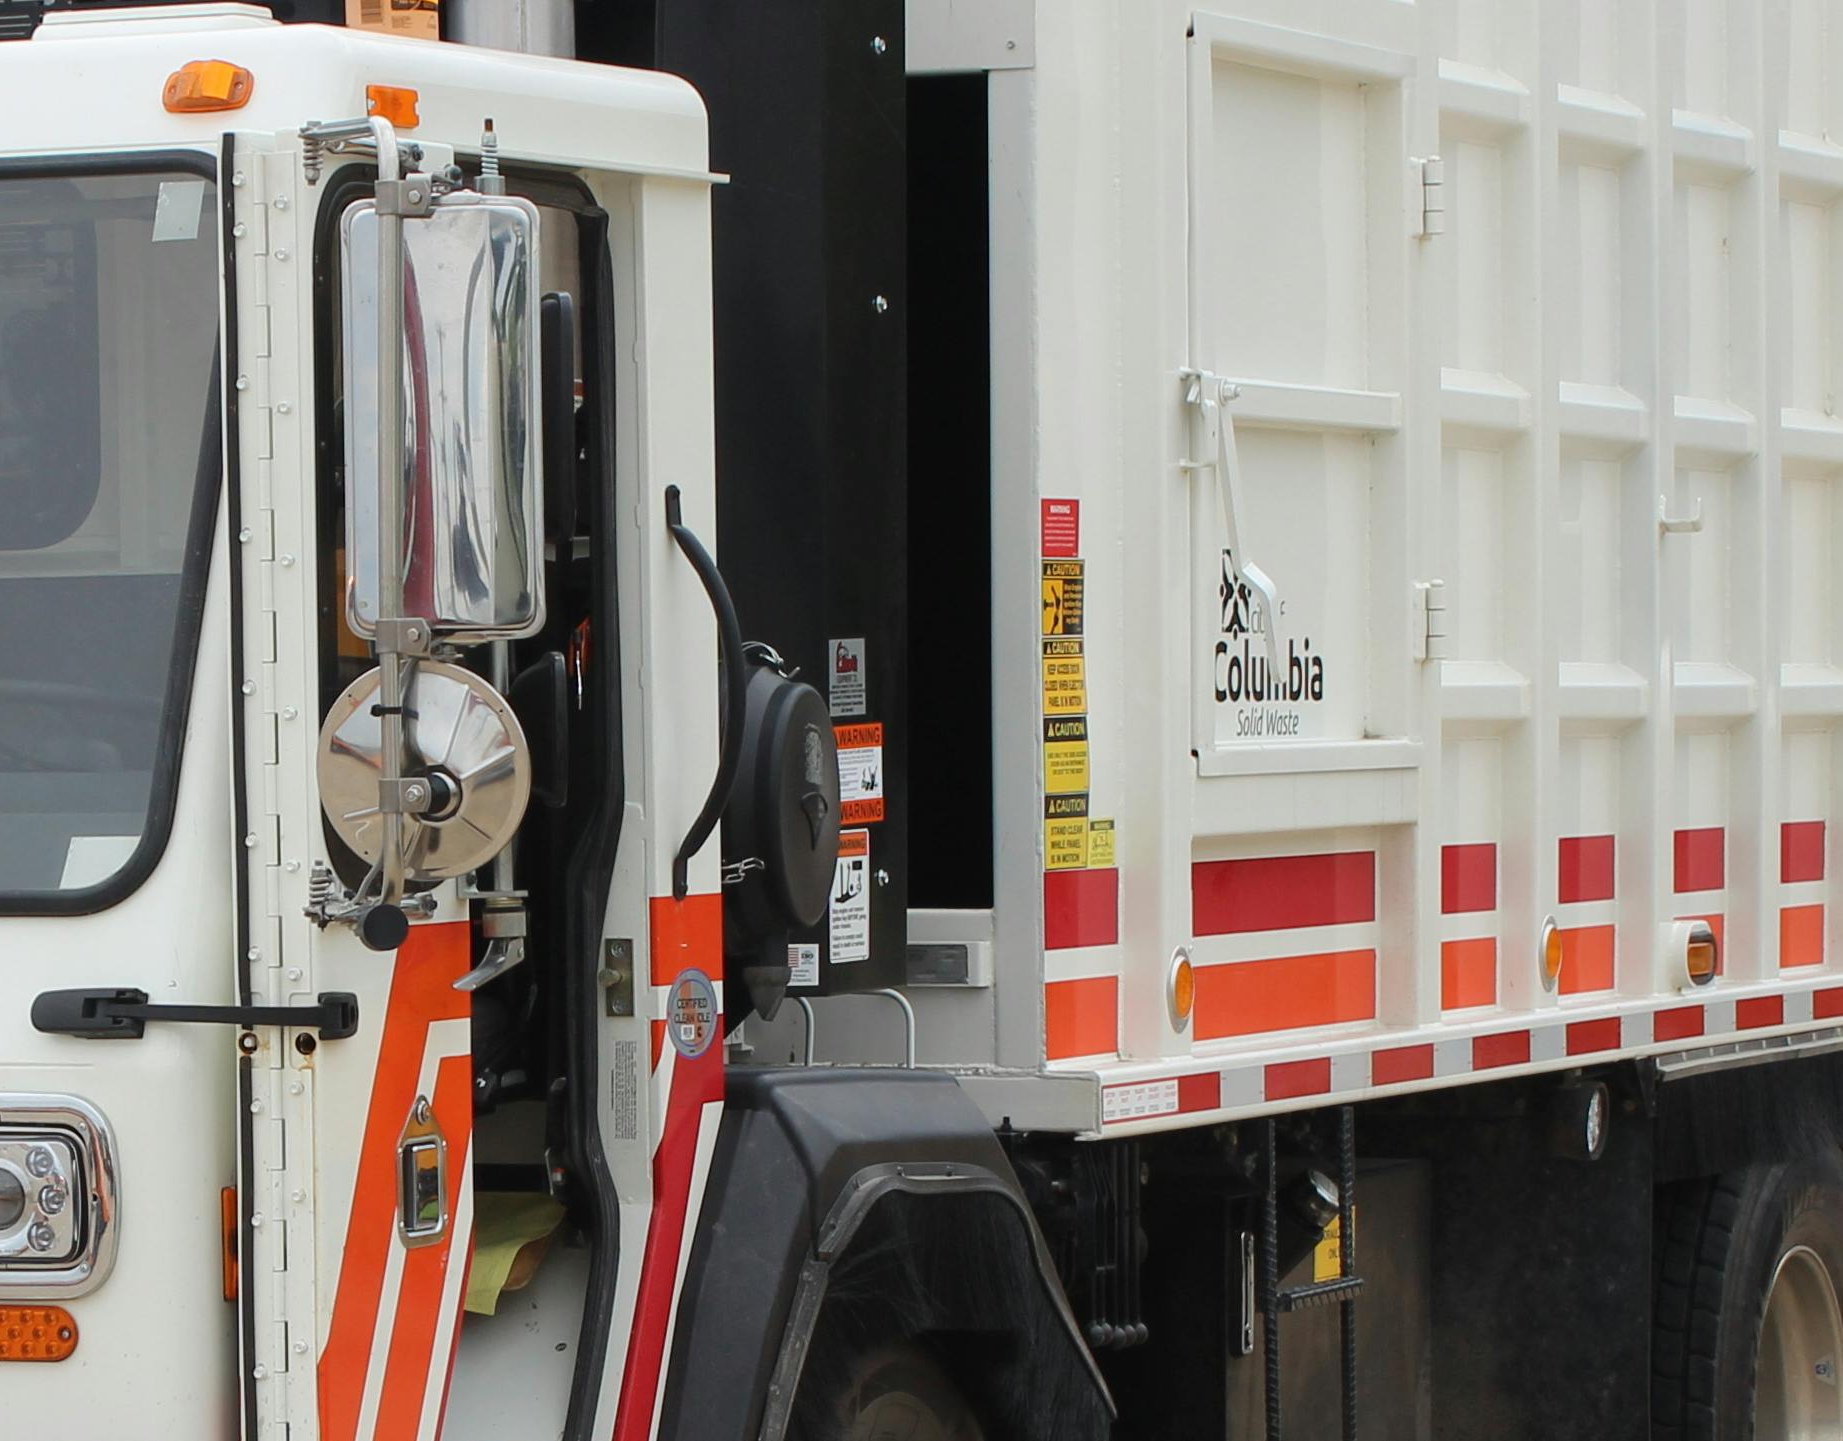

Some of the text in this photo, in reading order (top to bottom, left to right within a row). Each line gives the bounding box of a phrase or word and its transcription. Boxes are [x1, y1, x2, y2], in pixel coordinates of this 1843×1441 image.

[1052, 564, 1080, 576] CAUTION
[1052, 641, 1080, 654] CAUTION
[1236, 708, 1299, 736] Solid Waste
[1055, 722, 1085, 737] CAUTION
[838, 727, 880, 746] WARNING
[840, 801, 882, 821] WARNING
[1055, 798, 1086, 813] CAUTION
[1051, 824, 1083, 836] STAND CLEAR
[1051, 839, 1081, 850] WHILE PANEL
[1062, 853, 1080, 863] MOTION
[676, 998, 708, 1009] CERTIFIED
[674, 1013, 695, 1024] CLEAN
